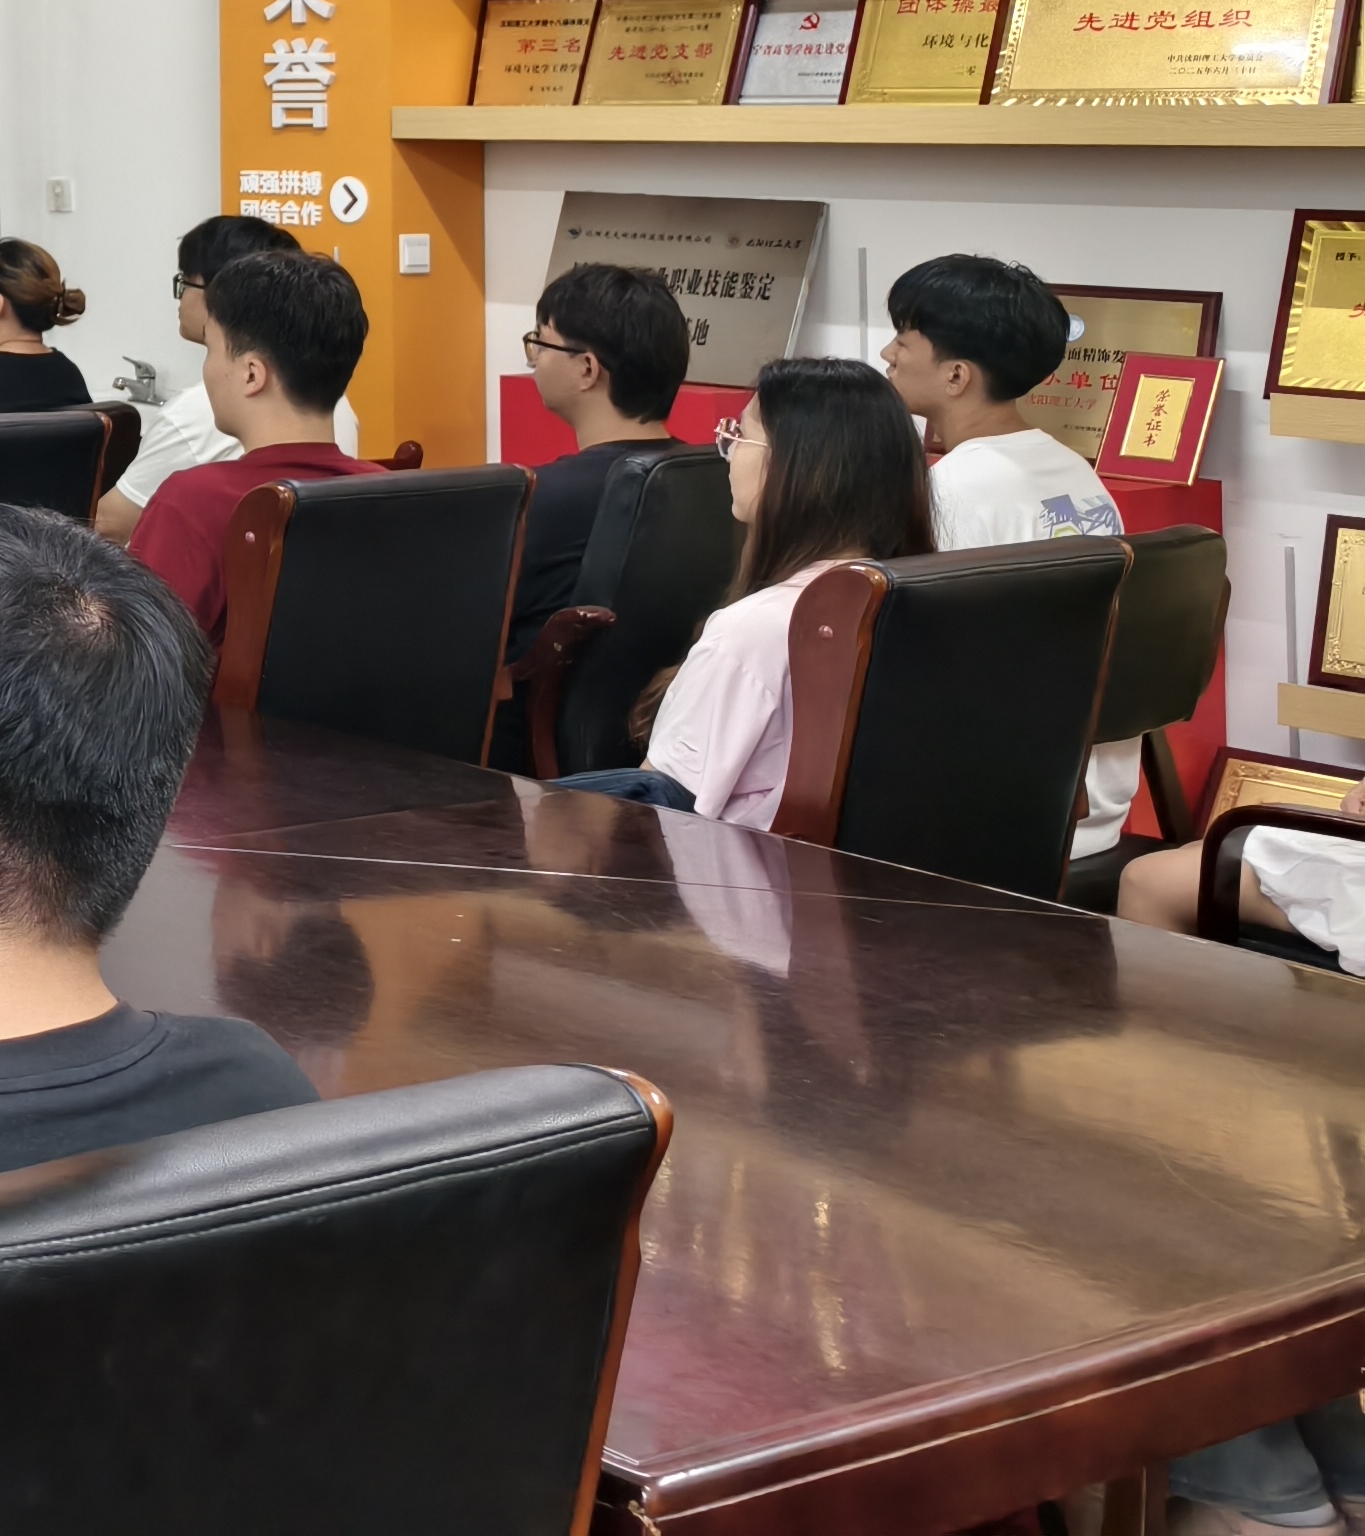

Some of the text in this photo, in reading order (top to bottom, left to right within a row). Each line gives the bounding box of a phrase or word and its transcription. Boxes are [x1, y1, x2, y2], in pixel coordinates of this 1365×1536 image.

[1072, 8, 1254, 32] 先进党组织
[517, 37, 581, 54] 第三名
[607, 43, 714, 61] 先进党支部
[239, 169, 322, 196] 顽强拼搏
[240, 199, 322, 226] 团结合作
[1143, 389, 1171, 448] 荣誉证书
